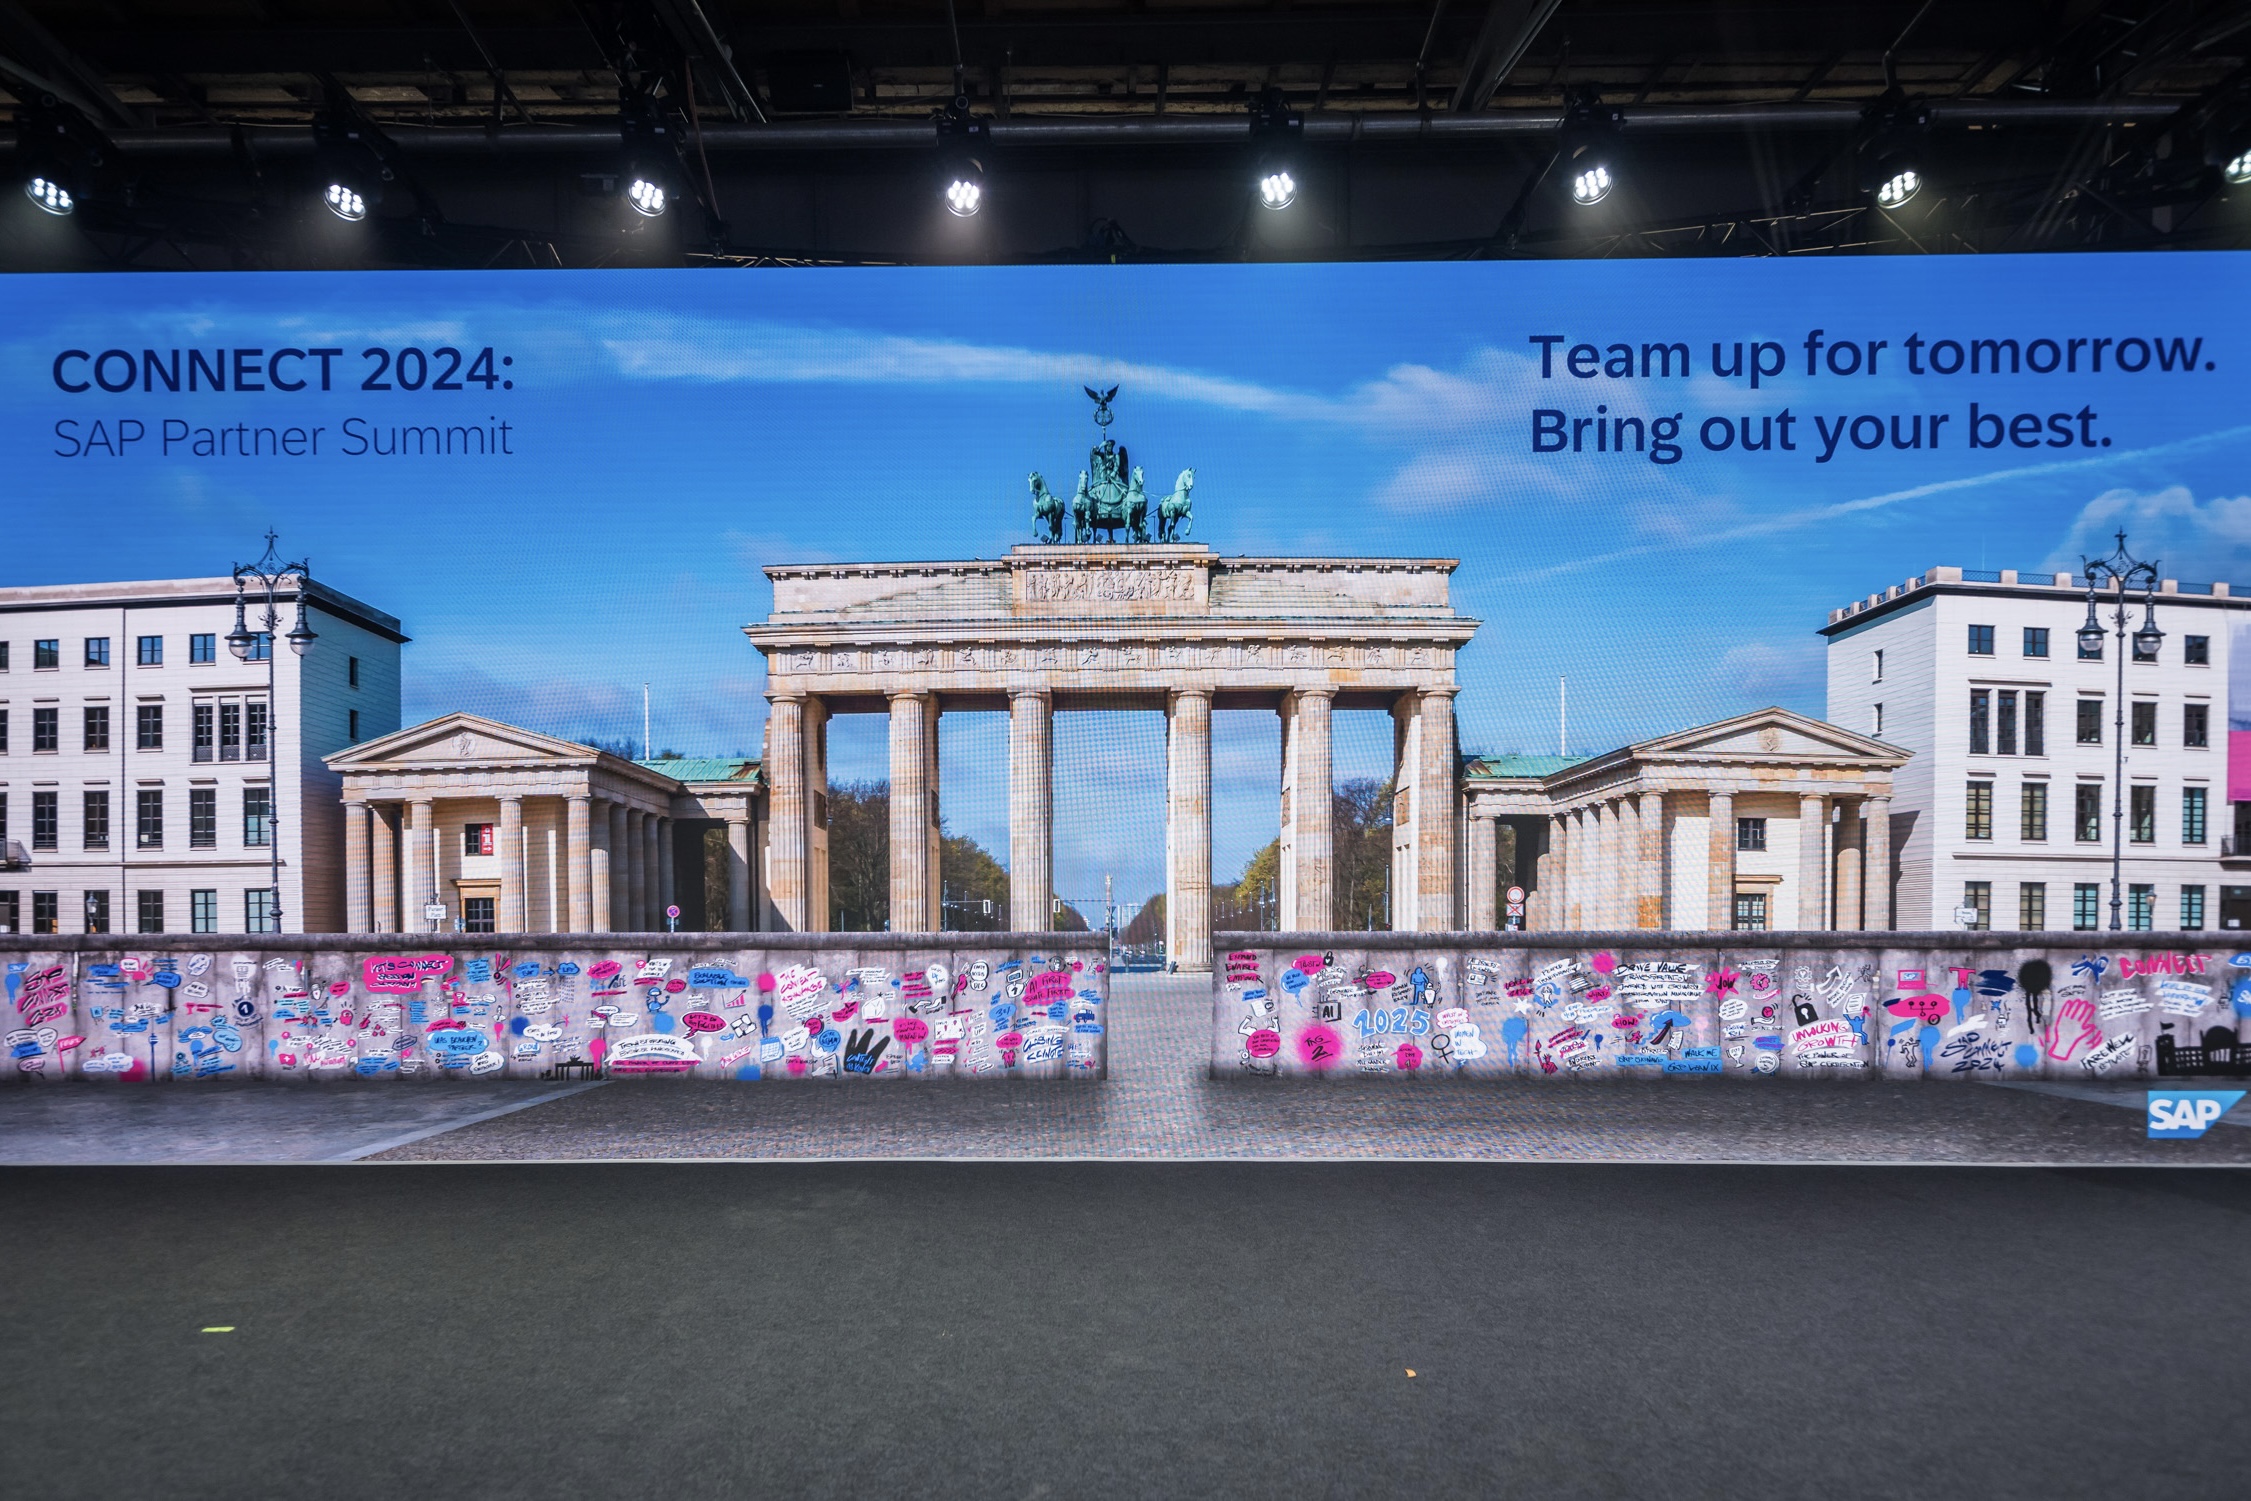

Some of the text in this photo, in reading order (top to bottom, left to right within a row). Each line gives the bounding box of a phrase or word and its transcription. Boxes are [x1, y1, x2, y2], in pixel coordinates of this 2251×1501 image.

[1529, 329, 2216, 390] Team up for tomorrow.
[52, 347, 514, 394] CONNECT 2024:
[55, 416, 513, 458] SAP Partner Summit
[1531, 402, 2112, 465] Bring out your best.
[1617, 961, 1688, 974] DRIVE VALUE
[2120, 950, 2212, 978] CONNECT
[1029, 975, 1068, 994] AI FIRST
[1047, 988, 1070, 998] FIRST
[1322, 1006, 1334, 1018] AI
[1352, 1008, 1430, 1038] 2025
[1305, 1035, 1324, 1047] TAG
[1798, 1036, 1858, 1052] GROWTH
[1312, 1046, 1328, 1062] 2
[1684, 1049, 1718, 1058] WALK ME
[2080, 1034, 2134, 1070] FAREWELL
[1951, 1058, 2004, 1073] 2024
[2149, 1099, 2221, 1130] SAP
